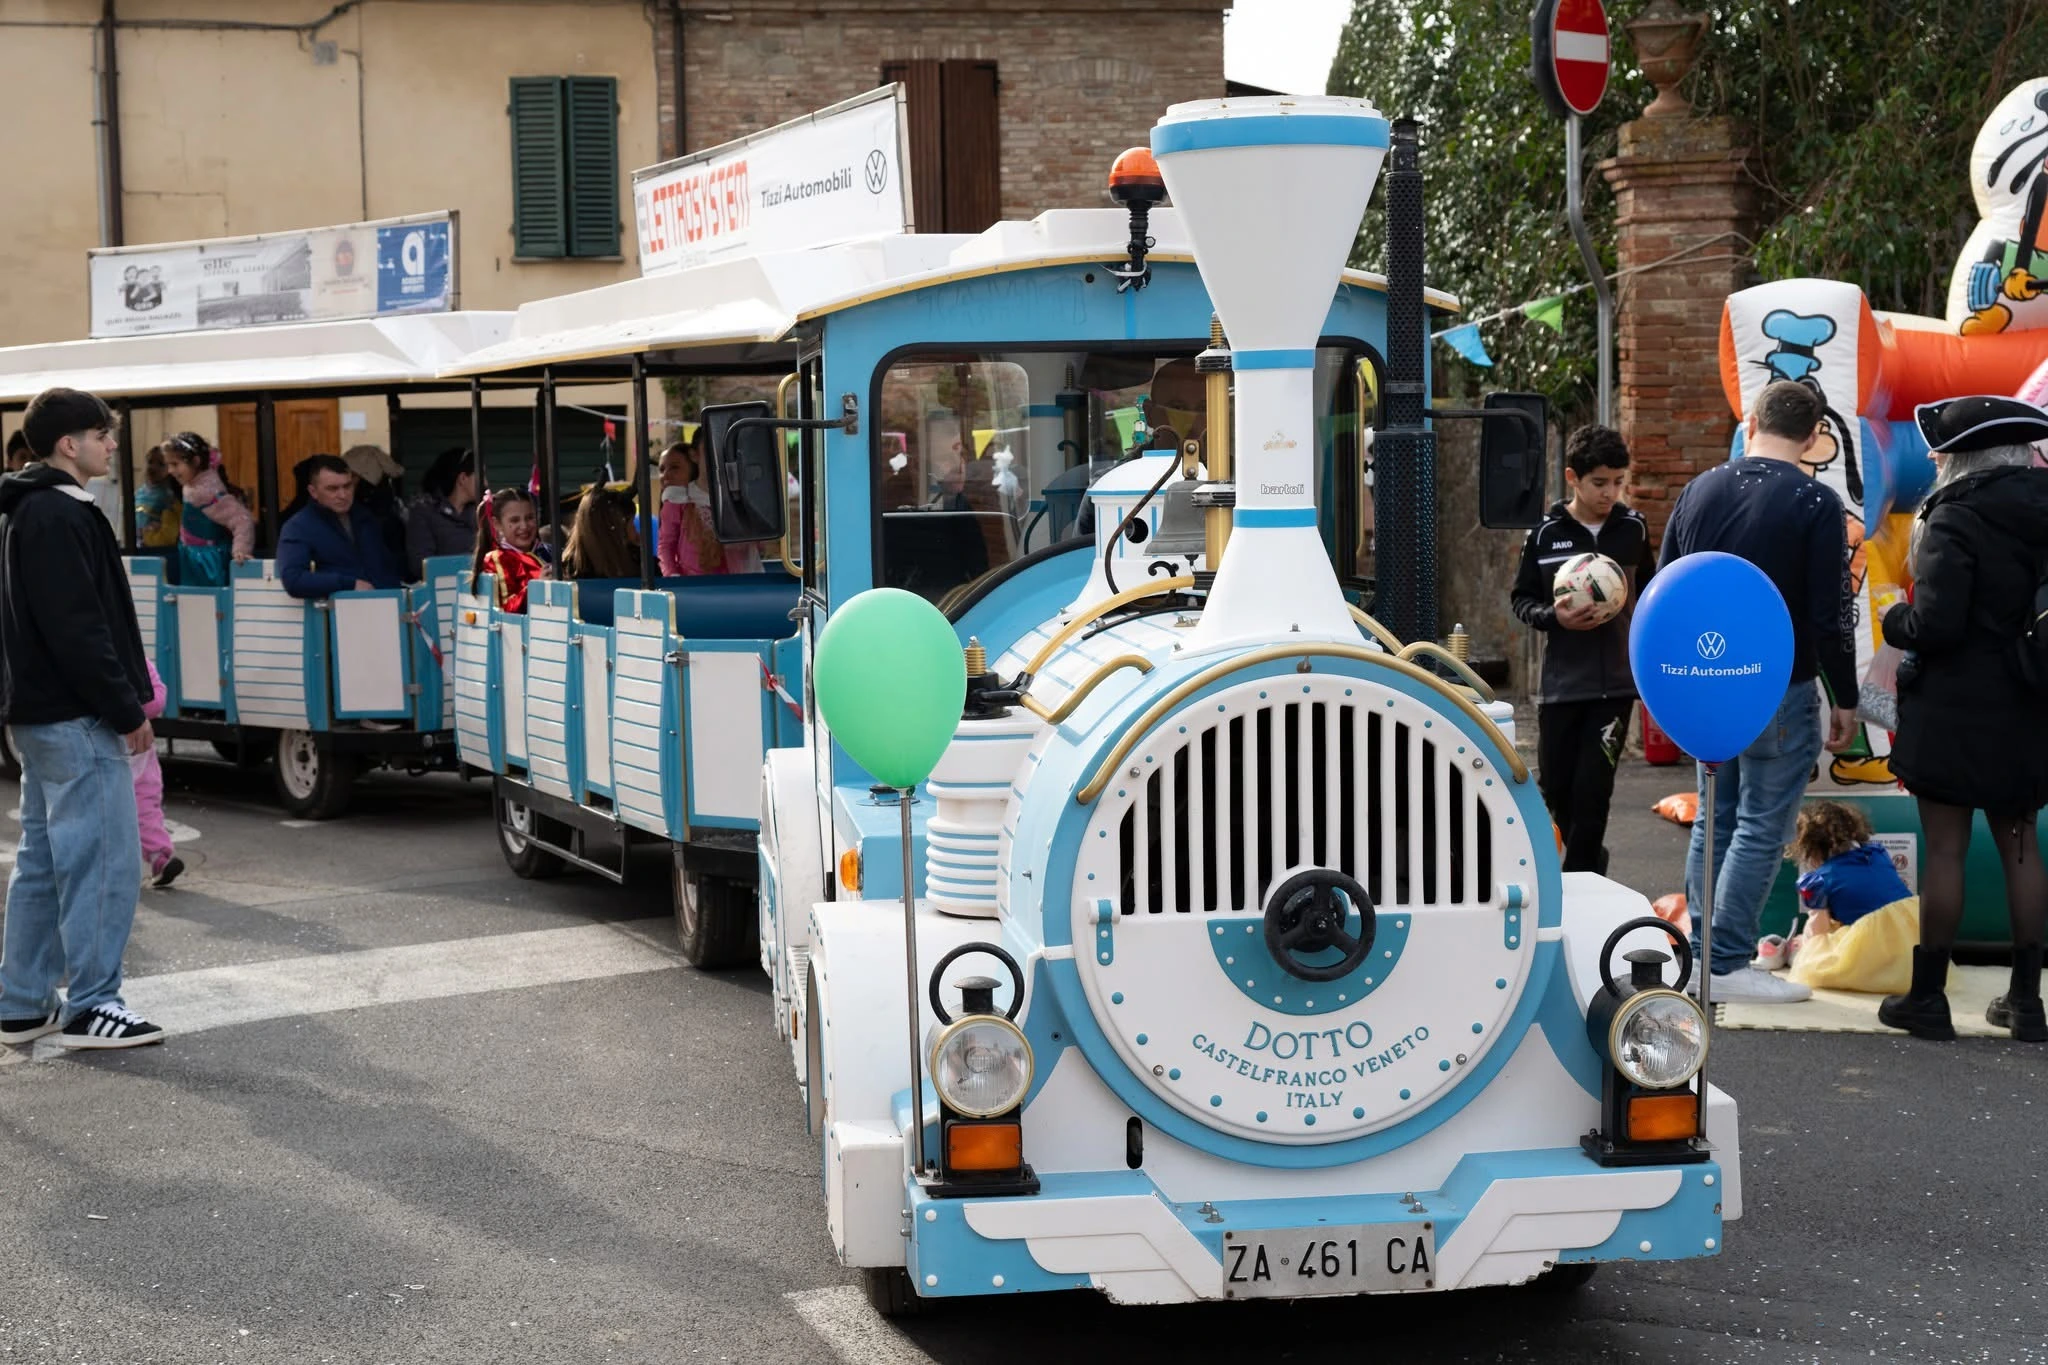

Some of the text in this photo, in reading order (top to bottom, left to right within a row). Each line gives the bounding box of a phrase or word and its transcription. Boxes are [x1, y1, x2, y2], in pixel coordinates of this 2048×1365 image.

[761, 167, 852, 208] Tizzi Automobili
[1260, 483, 1305, 495] bartoli
[1552, 540, 1573, 550] JAKO
[1842, 571, 1851, 600] LOS
[1840, 604, 1855, 654] GUESS
[1660, 663, 1762, 677] Tizzi Automobili
[1192, 1026, 1430, 1087] CASTELFRANCO VENETO
[1243, 1020, 1373, 1060] DOTTO
[1286, 1090, 1344, 1109] ITALY
[1228, 1235, 1430, 1283] ZA 461 CA
